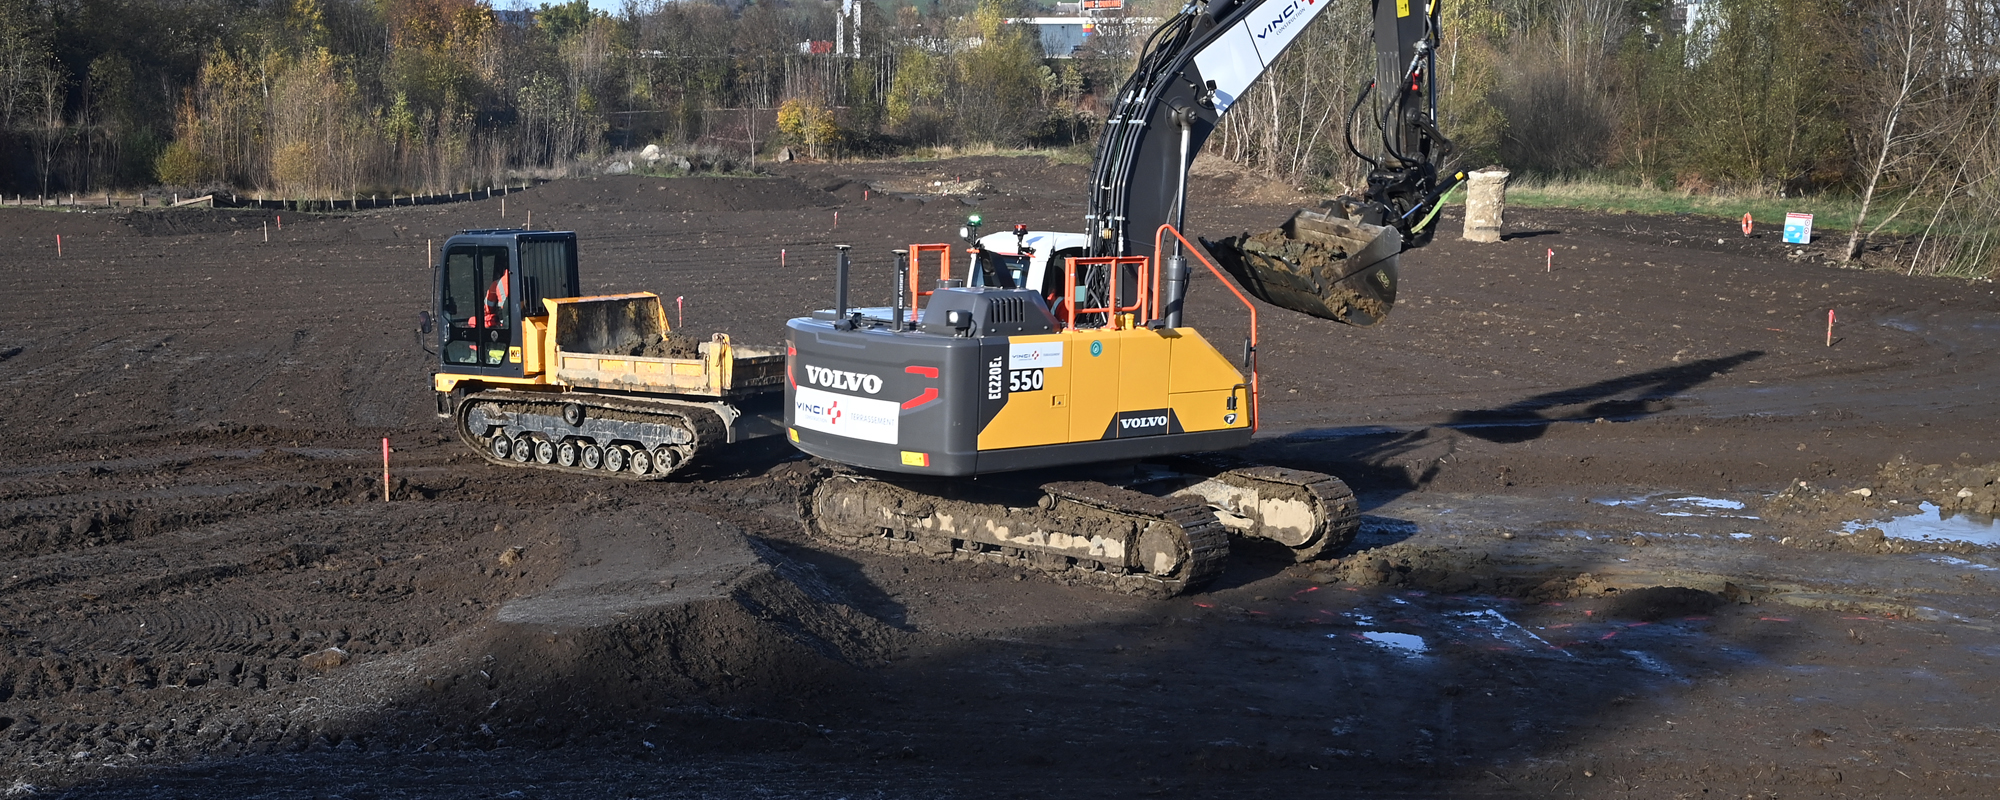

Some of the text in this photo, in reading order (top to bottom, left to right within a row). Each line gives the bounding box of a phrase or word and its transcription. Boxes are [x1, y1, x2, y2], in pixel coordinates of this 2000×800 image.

[1257, 1, 1299, 39] VINCI
[1275, 7, 1306, 36] CONSTRUCTION
[805, 364, 883, 394] VOLVO
[1009, 369, 1043, 392] 550
[796, 401, 824, 416] VINCI
[850, 412, 895, 426] TERRASSEMENT
[1120, 416, 1167, 428] VOLVO
